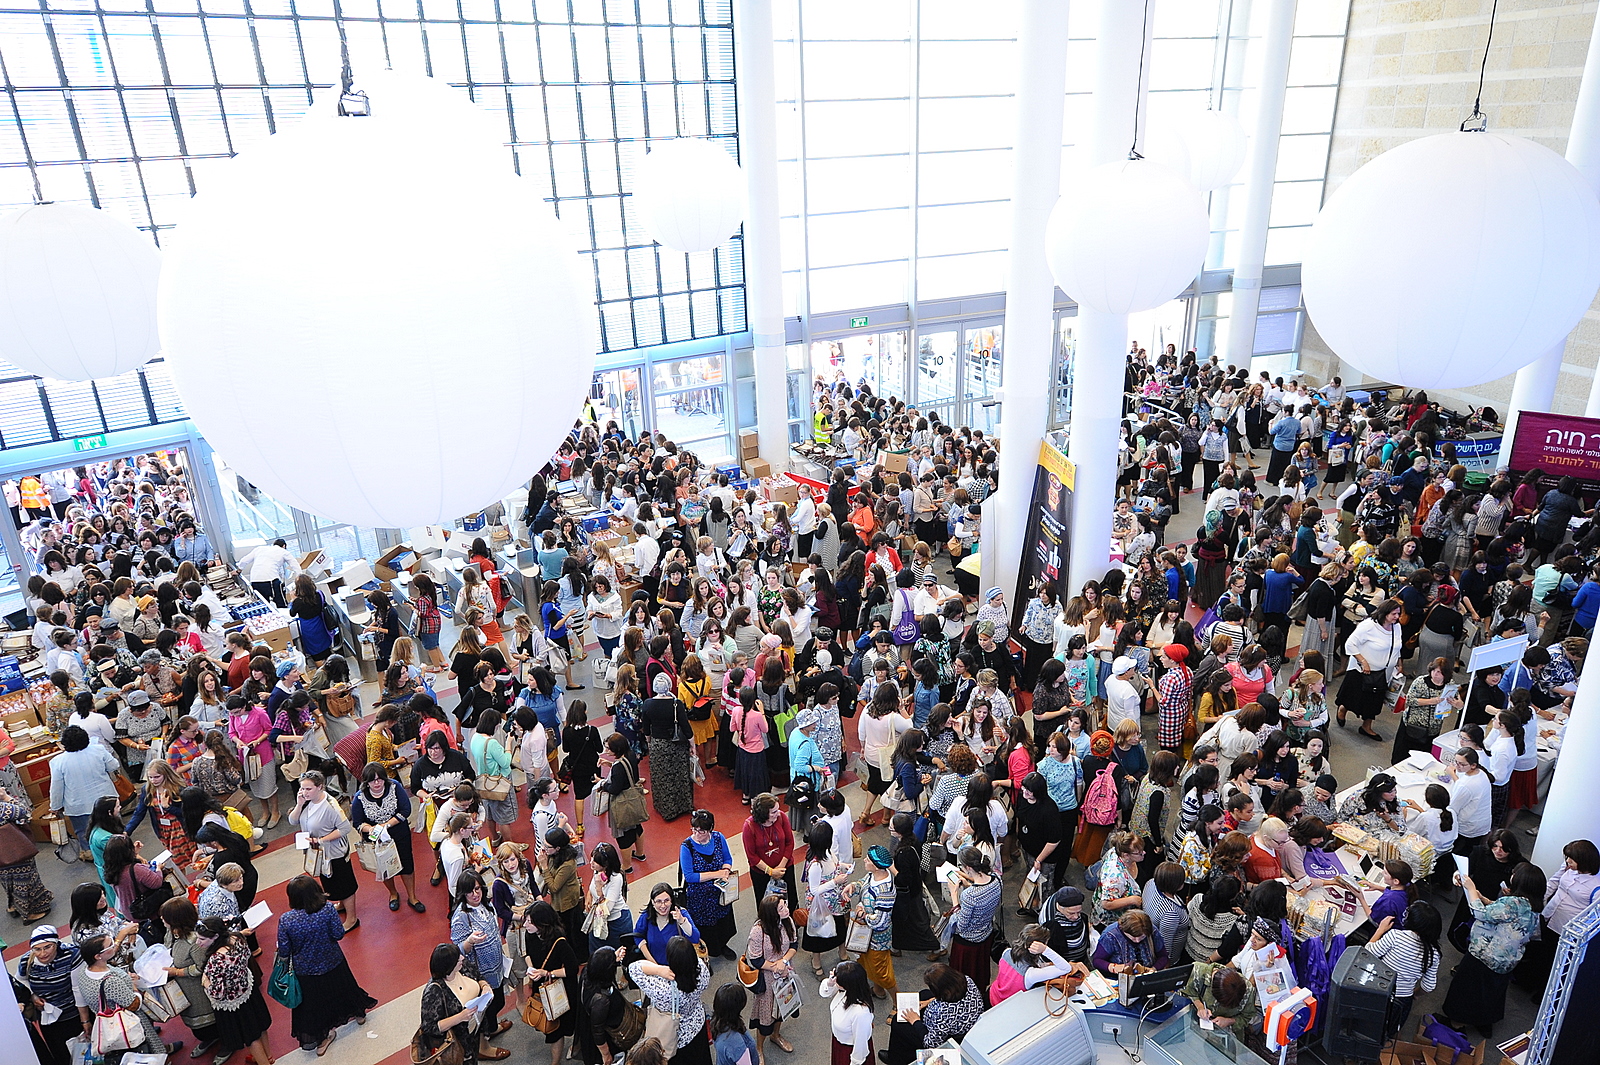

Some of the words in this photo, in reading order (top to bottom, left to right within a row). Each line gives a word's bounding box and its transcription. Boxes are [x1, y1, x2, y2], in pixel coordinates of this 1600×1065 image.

[979, 349, 989, 360] 10
[933, 355, 944, 366] 10
[1545, 429, 1587, 448] חיה
[1566, 447, 1585, 455] לאשה
